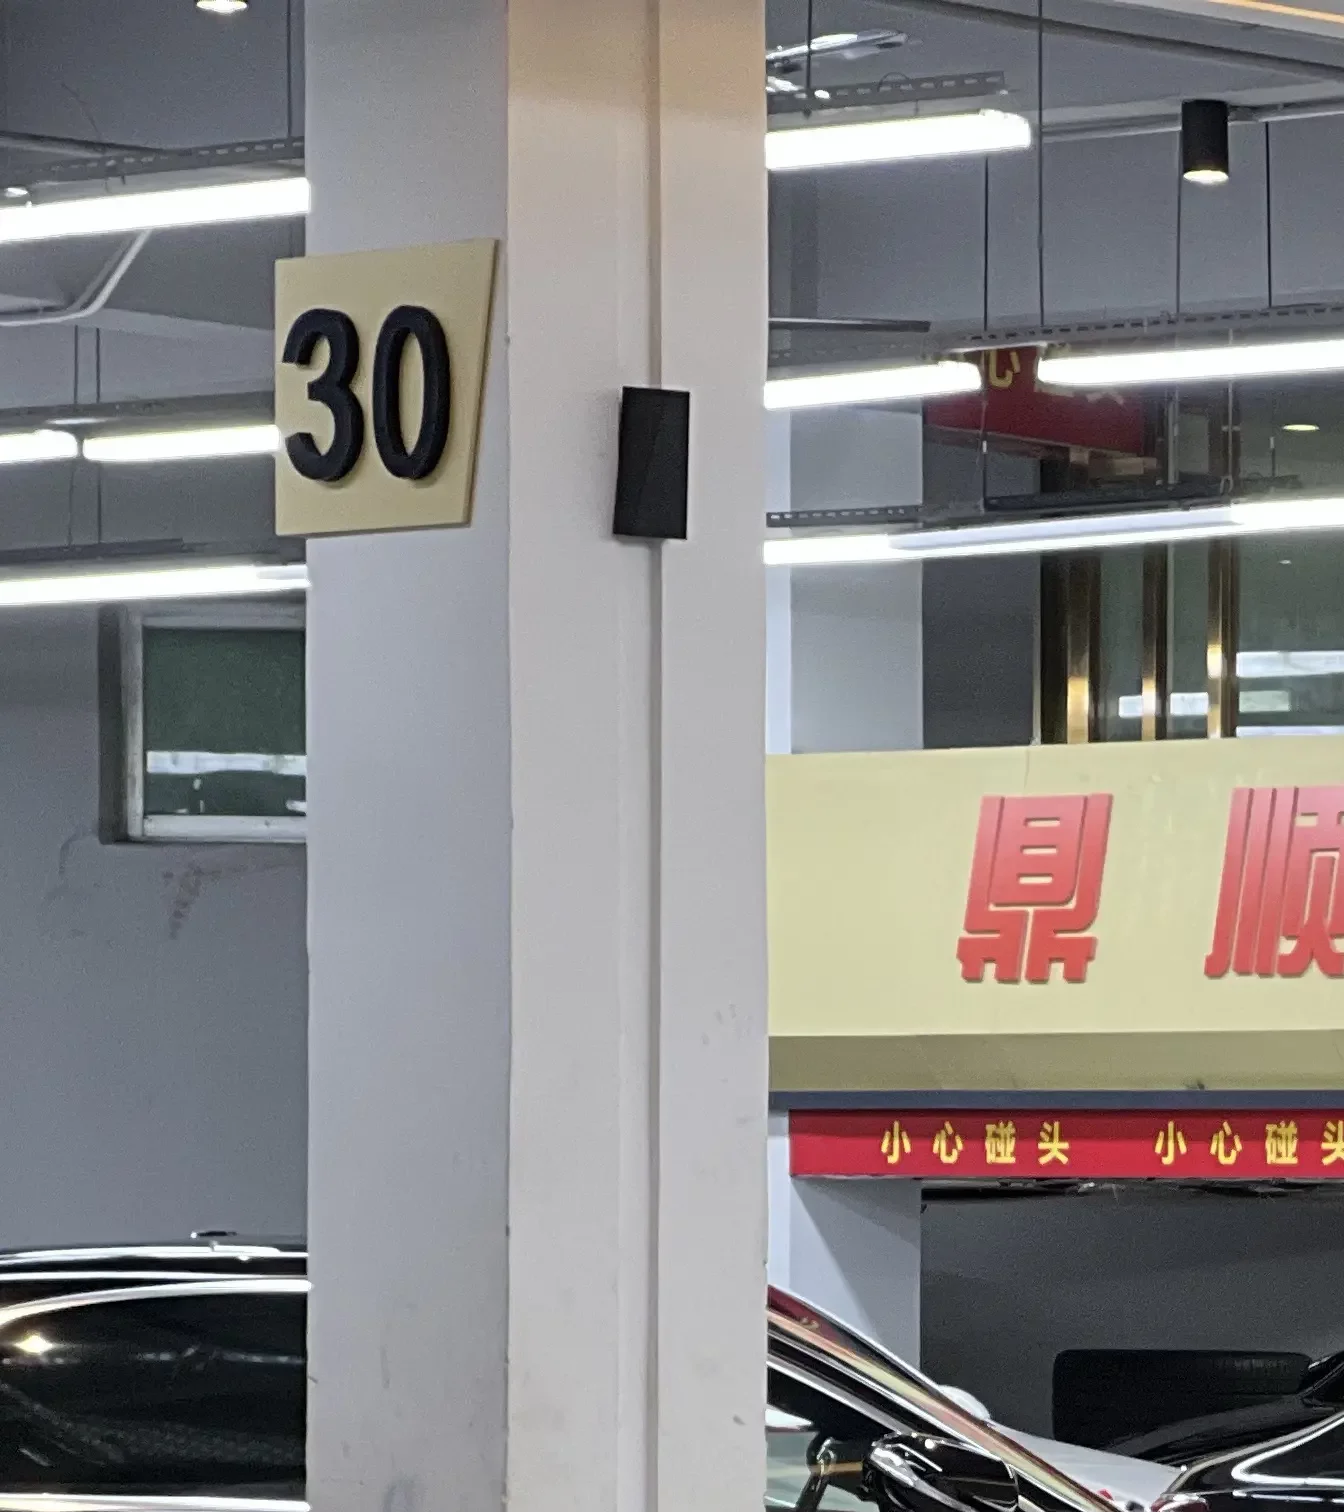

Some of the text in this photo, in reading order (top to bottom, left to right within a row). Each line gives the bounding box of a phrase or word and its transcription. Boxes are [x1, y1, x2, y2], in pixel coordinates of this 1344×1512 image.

[283, 304, 453, 482] 30
[880, 1120, 1070, 1166] 小心碰头
